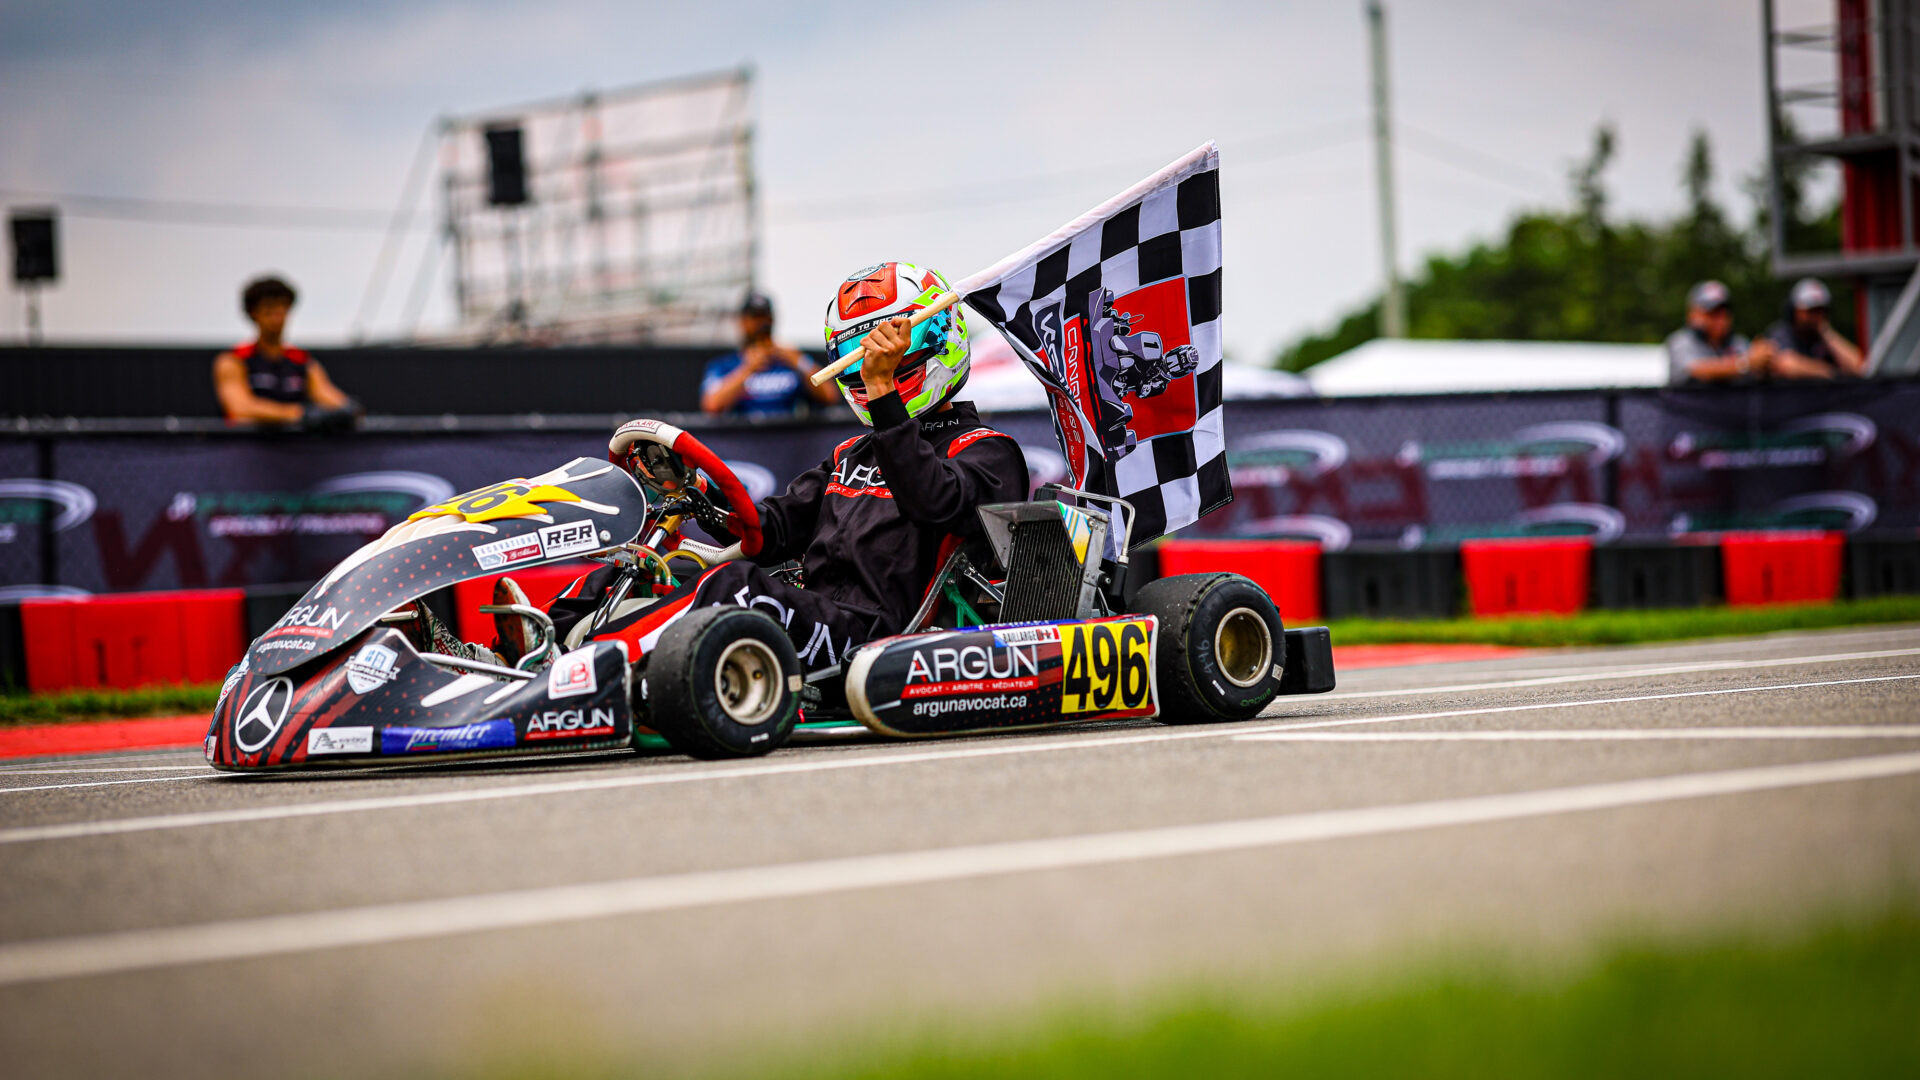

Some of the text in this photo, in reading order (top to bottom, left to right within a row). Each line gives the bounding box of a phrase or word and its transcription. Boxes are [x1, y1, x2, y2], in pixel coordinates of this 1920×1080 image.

[837, 328, 856, 341] ROAD
[859, 322, 870, 331] TO
[547, 525, 593, 546] R2R
[905, 644, 1039, 685] ARGUN
[1065, 624, 1148, 710] 496
[909, 679, 1034, 695] AVOCAT ARBITRE MÉDIATEUR
[913, 693, 1028, 718] argunavocat.ca
[526, 707, 615, 733] ARGUN
[405, 723, 492, 752] premier
